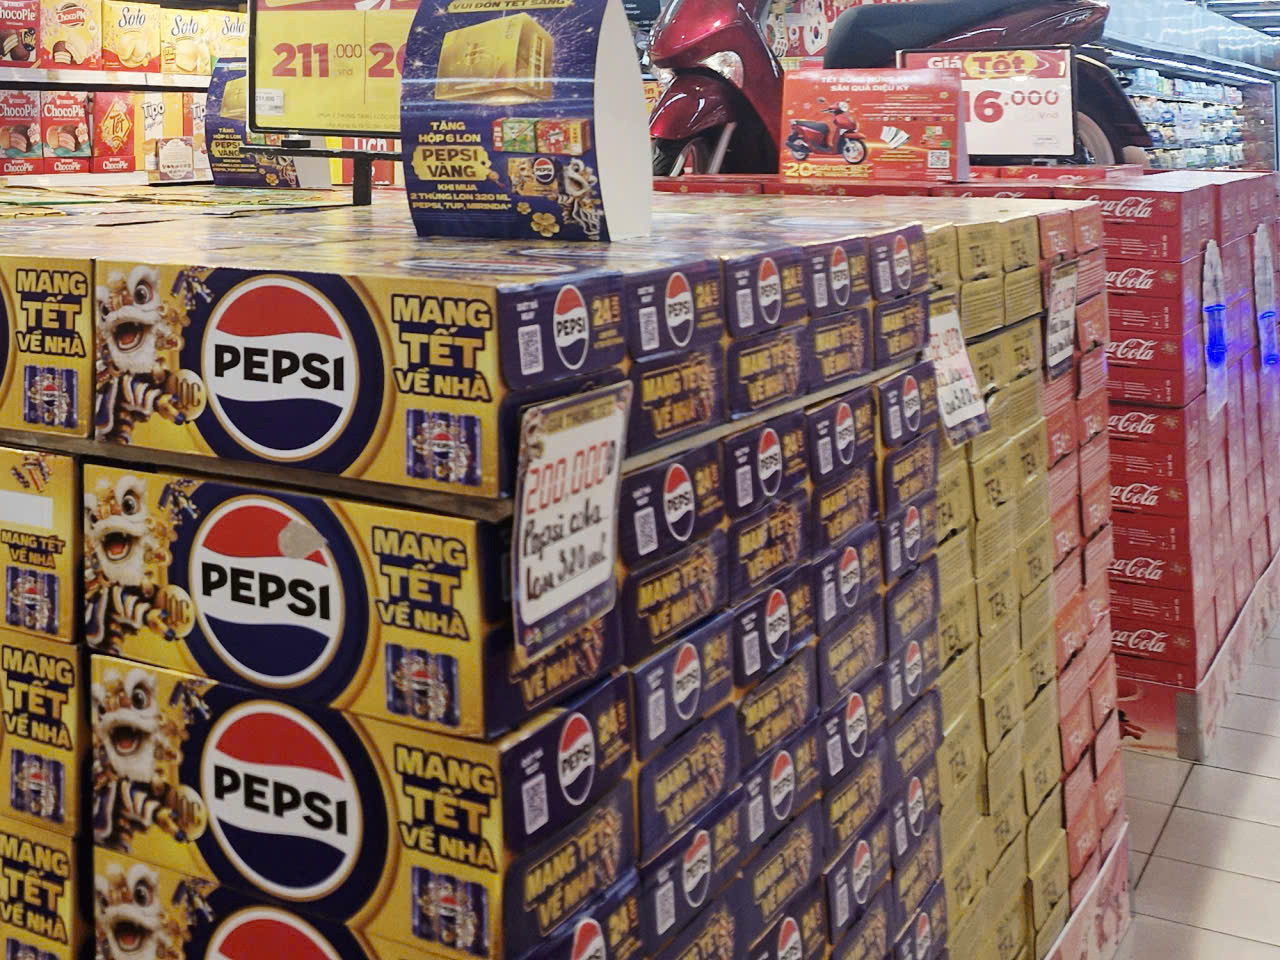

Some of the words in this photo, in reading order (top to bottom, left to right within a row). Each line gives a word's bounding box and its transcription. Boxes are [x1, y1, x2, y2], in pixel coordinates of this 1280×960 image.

[272, 43, 330, 78] 211
[927, 53, 963, 69] Giá
[971, 52, 1026, 76] Tốt
[43, 105, 85, 118] ChocoPie
[142, 102, 165, 119] Tipo
[191, 102, 206, 118] Tip
[430, 120, 466, 132] TẶNG
[418, 132, 444, 144] HỘP
[445, 134, 455, 143] 6
[455, 134, 481, 143] LON
[422, 148, 479, 162] PEPSI
[4, 162, 33, 173] ChocoPie
[53, 162, 81, 172] ChocoPie
[102, 160, 129, 171] ChocoPie
[427, 161, 477, 178] VÀNG
[17, 270, 87, 296] MANG
[760, 284, 780, 302] PEPSI
[22, 295, 81, 330] TẾT
[392, 294, 492, 330] MANG
[667, 300, 693, 320] PEPSI
[556, 317, 589, 337] PEPSI
[44, 332, 85, 355] NHÀ
[400, 326, 485, 369] TẾT
[214, 343, 345, 391] PEPSI
[433, 373, 491, 400] NHÀ
[201, 562, 330, 620] PEPSI
[214, 764, 348, 836] PEPSI
